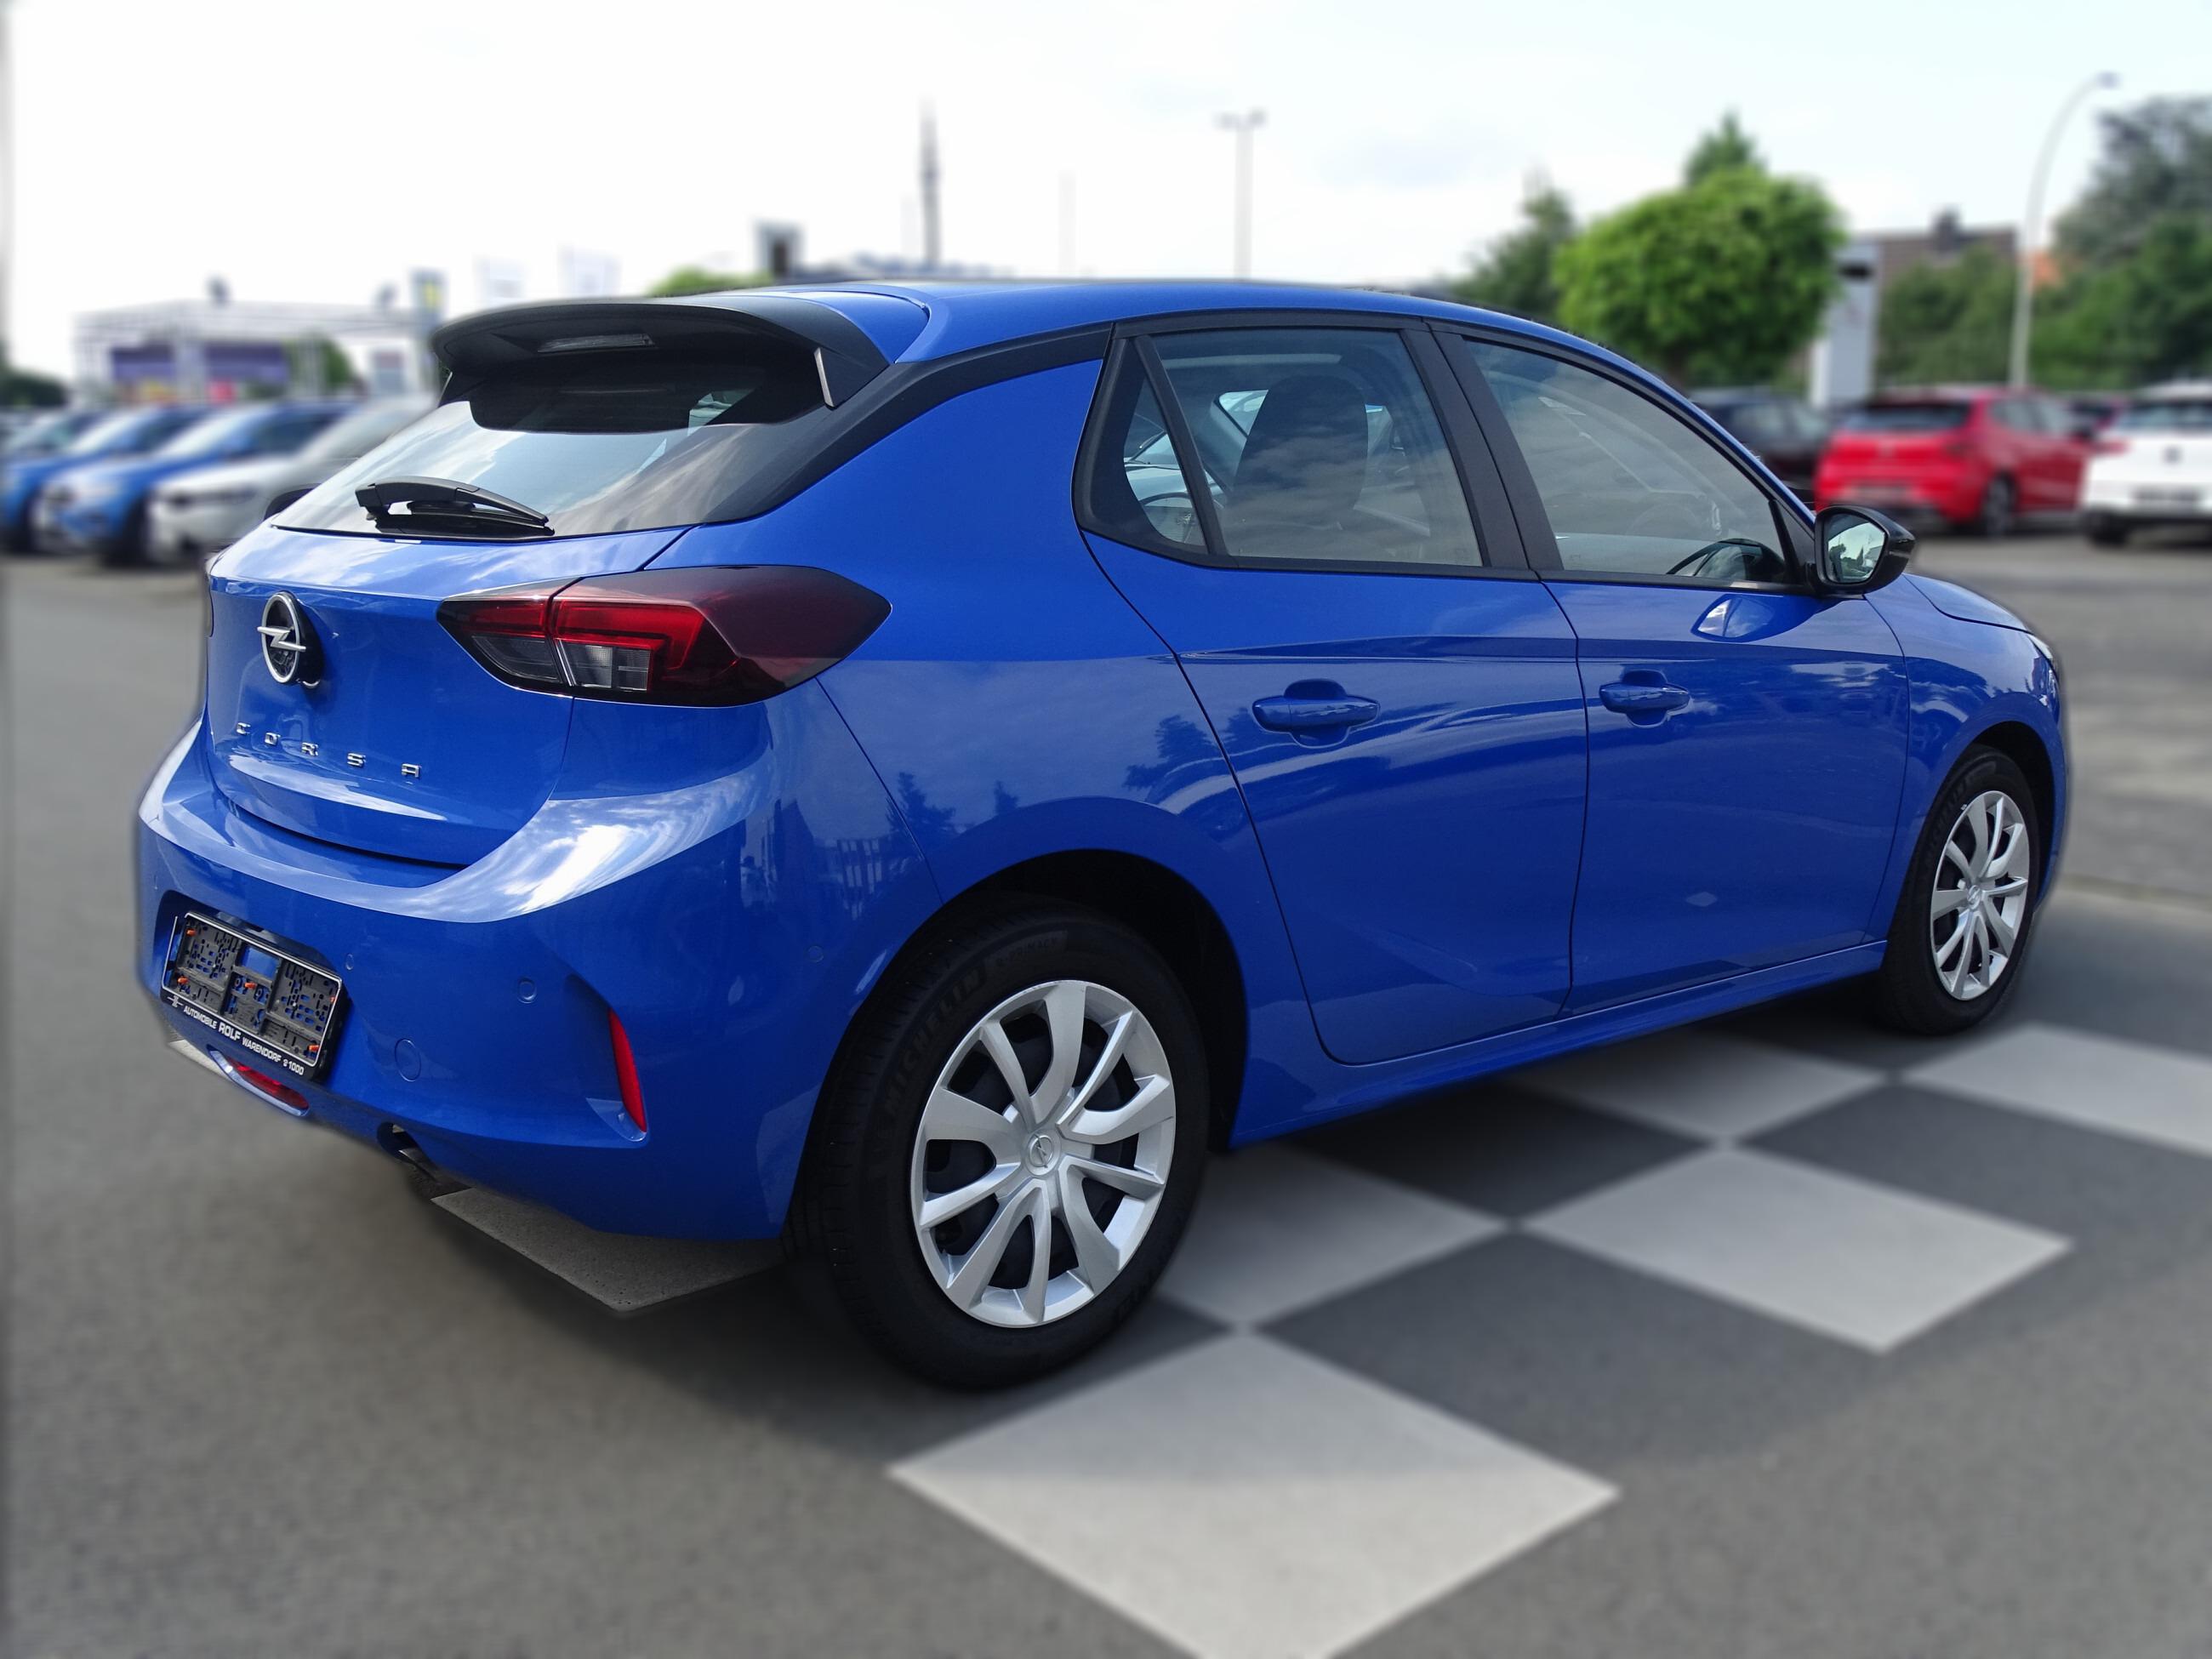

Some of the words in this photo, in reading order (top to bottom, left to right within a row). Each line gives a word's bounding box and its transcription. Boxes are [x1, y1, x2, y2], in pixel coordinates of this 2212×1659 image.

[237, 722, 421, 778] CORSA
[184, 1006, 218, 1029] AUTOMOBILE
[219, 1023, 242, 1041] ROLF
[242, 1037, 282, 1063] WARENDORF
